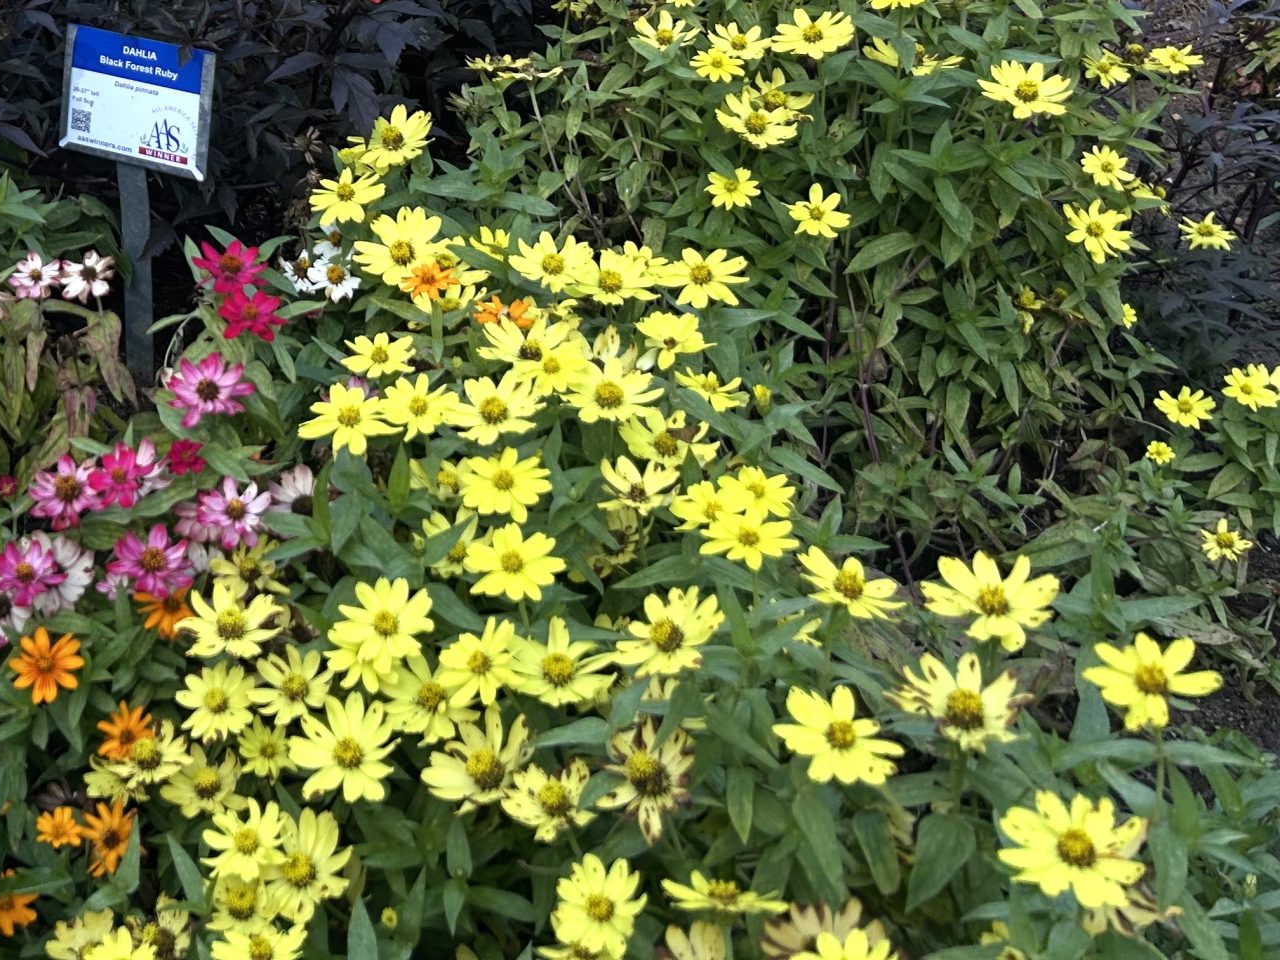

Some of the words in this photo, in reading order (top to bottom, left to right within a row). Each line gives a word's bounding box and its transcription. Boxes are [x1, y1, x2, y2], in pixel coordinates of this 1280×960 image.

[122, 45, 157, 61] DAHLIA
[99, 54, 124, 68] Black
[125, 61, 153, 74] Forest
[154, 67, 178, 81] Ruby
[77, 135, 132, 153] aaswinners.com
[146, 118, 180, 153] AAS
[145, 148, 181, 163] WINNER
